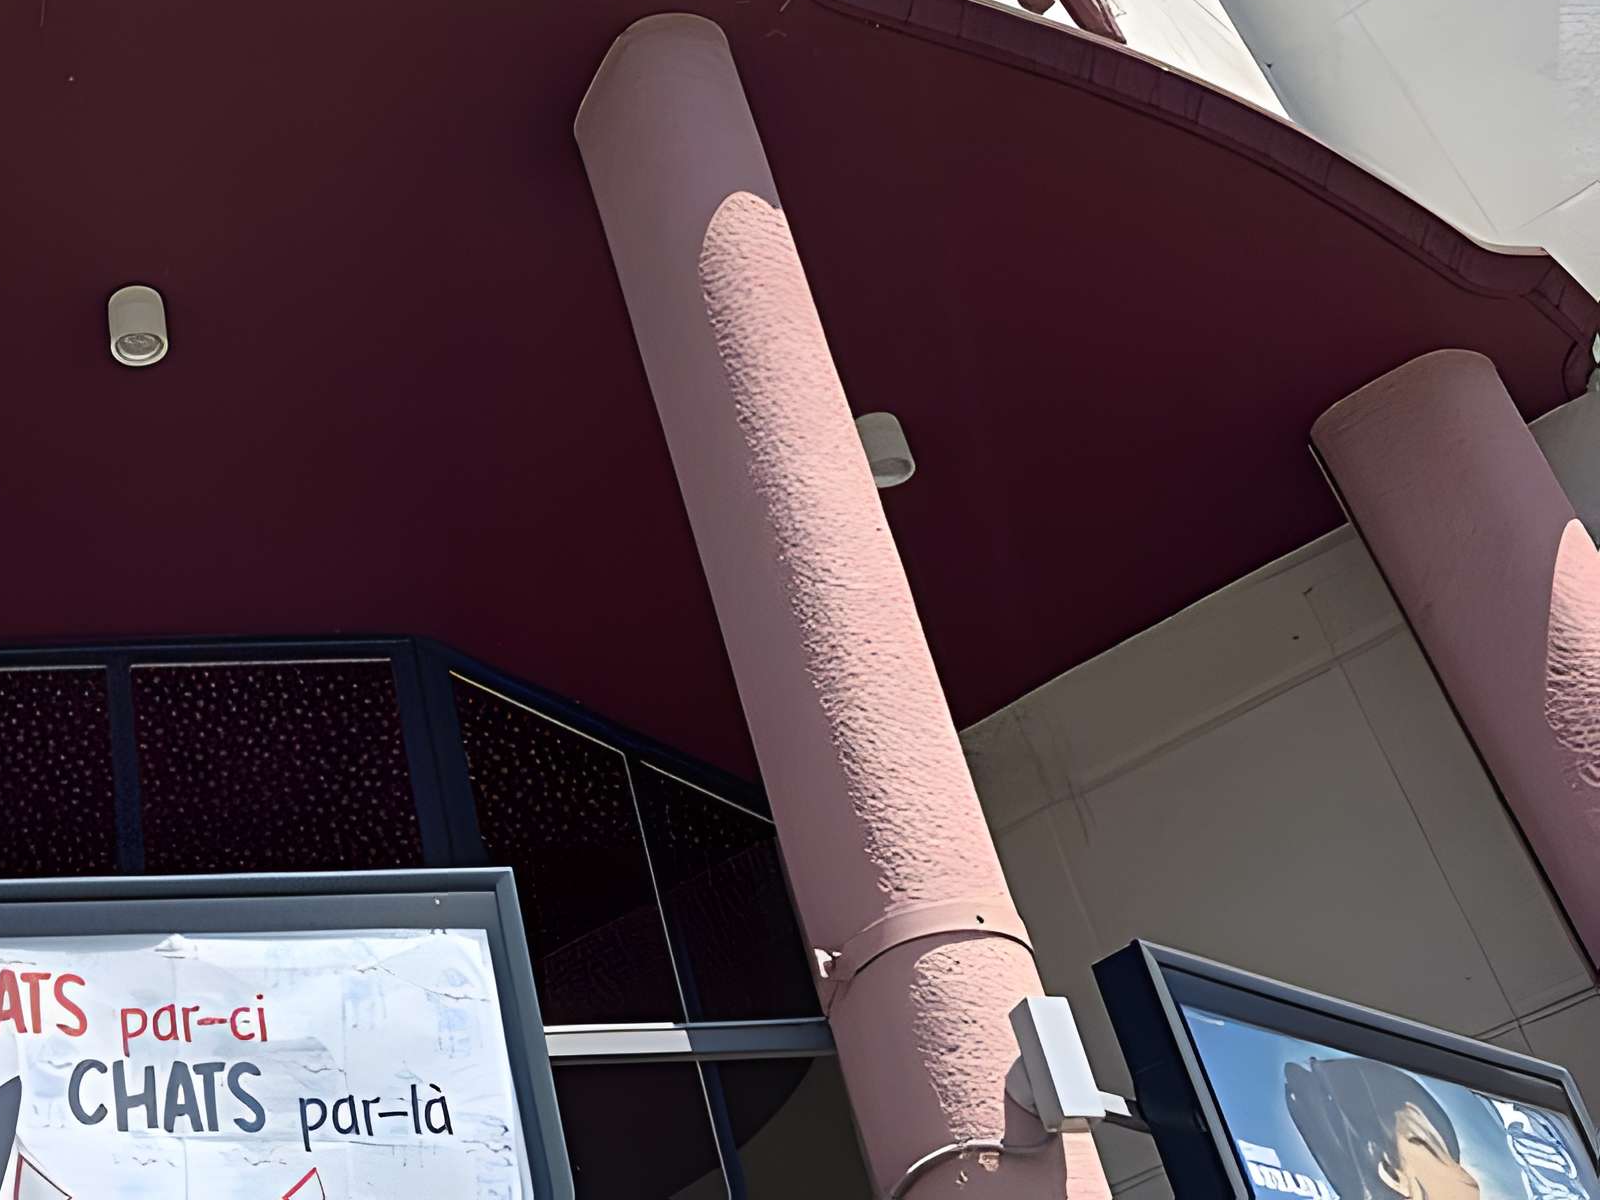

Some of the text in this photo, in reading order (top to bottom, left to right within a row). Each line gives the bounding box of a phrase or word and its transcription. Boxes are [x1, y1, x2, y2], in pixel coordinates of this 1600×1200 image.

[120, 993, 269, 1057] par-ci
[67, 1058, 454, 1152] CHATS par-là
